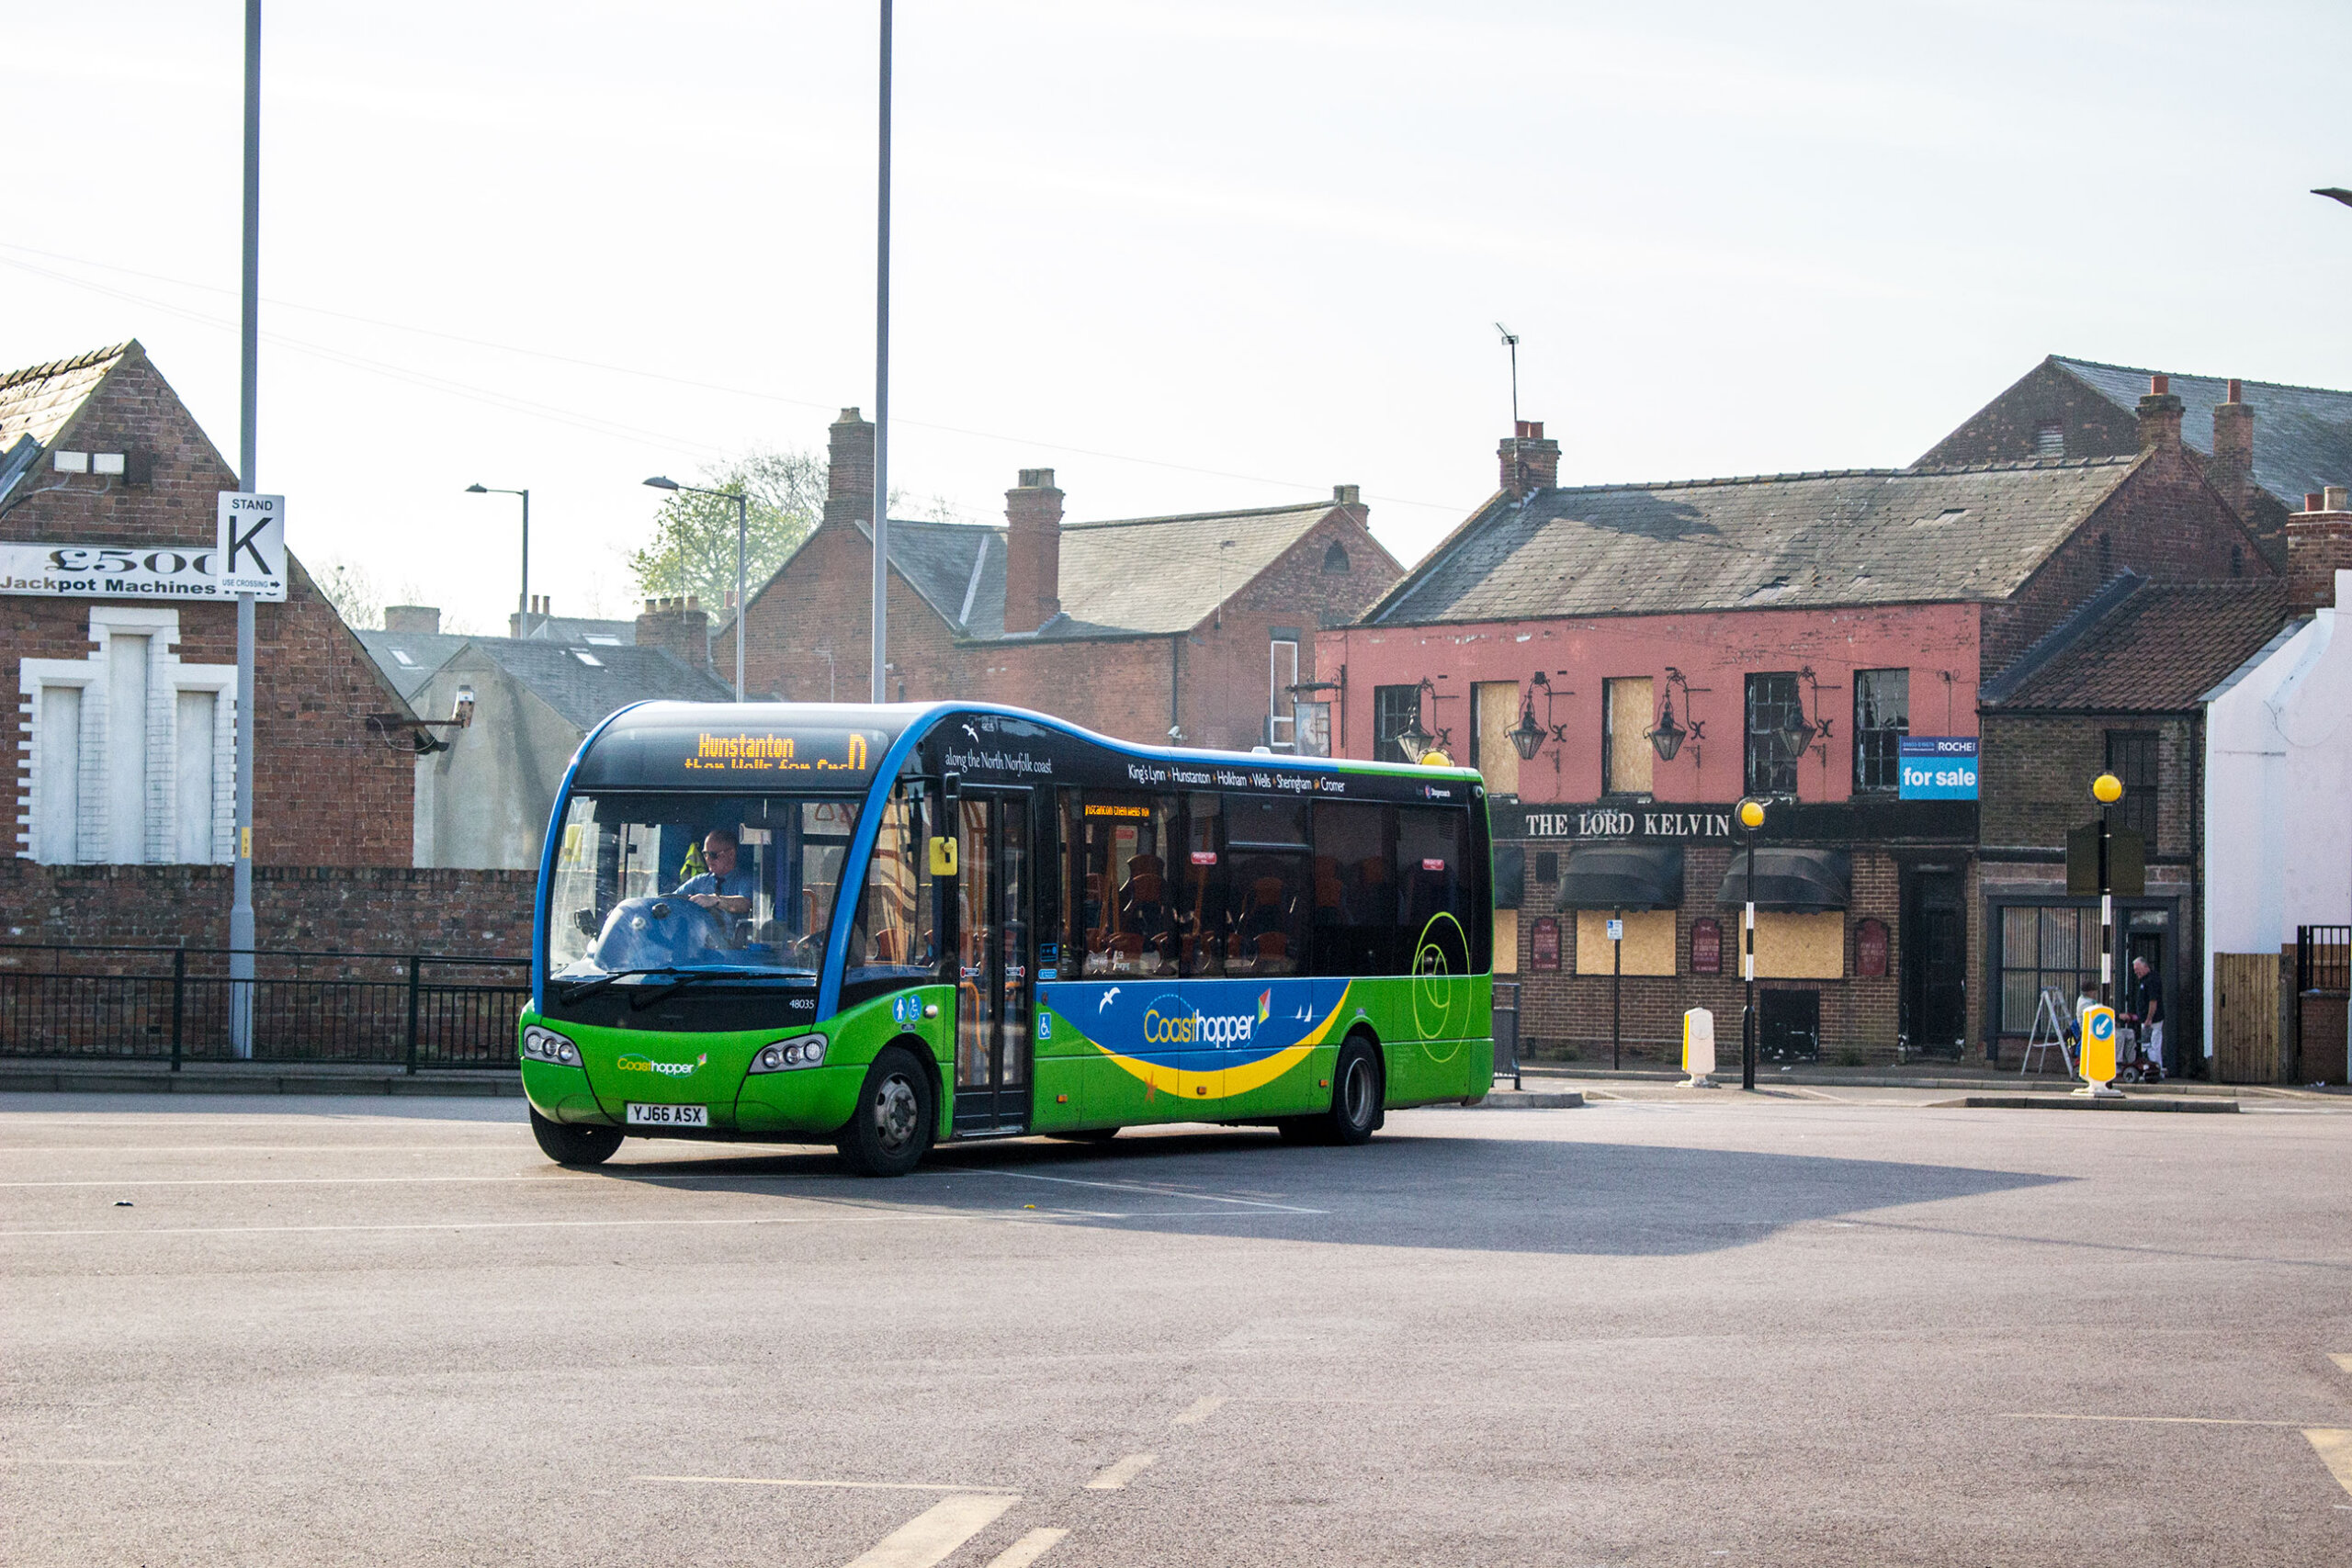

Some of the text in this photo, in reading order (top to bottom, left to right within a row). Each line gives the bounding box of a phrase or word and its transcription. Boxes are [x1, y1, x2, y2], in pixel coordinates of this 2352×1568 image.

[232, 499, 273, 511] STAND
[228, 515, 273, 575] K
[0, 576, 217, 595] Jackpot Machines
[222, 579, 268, 588] USE CROSSING
[698, 733, 794, 758] Hunstanton
[1938, 741, 1973, 751] ROCHE
[944, 746, 1052, 777] along the North Norfolk coast
[1128, 763, 1345, 794] King's Lynn Hunstanton Holkham Wells Sheringham Cromer
[1904, 767, 1976, 786] for sale
[1526, 813, 1731, 836] THE LORD KELVIN
[789, 999, 815, 1010] 48035
[1144, 1009, 1255, 1048] Coasthopper
[617, 1058, 695, 1076] Coasthopper
[634, 1106, 702, 1122] YJ66 ASX
